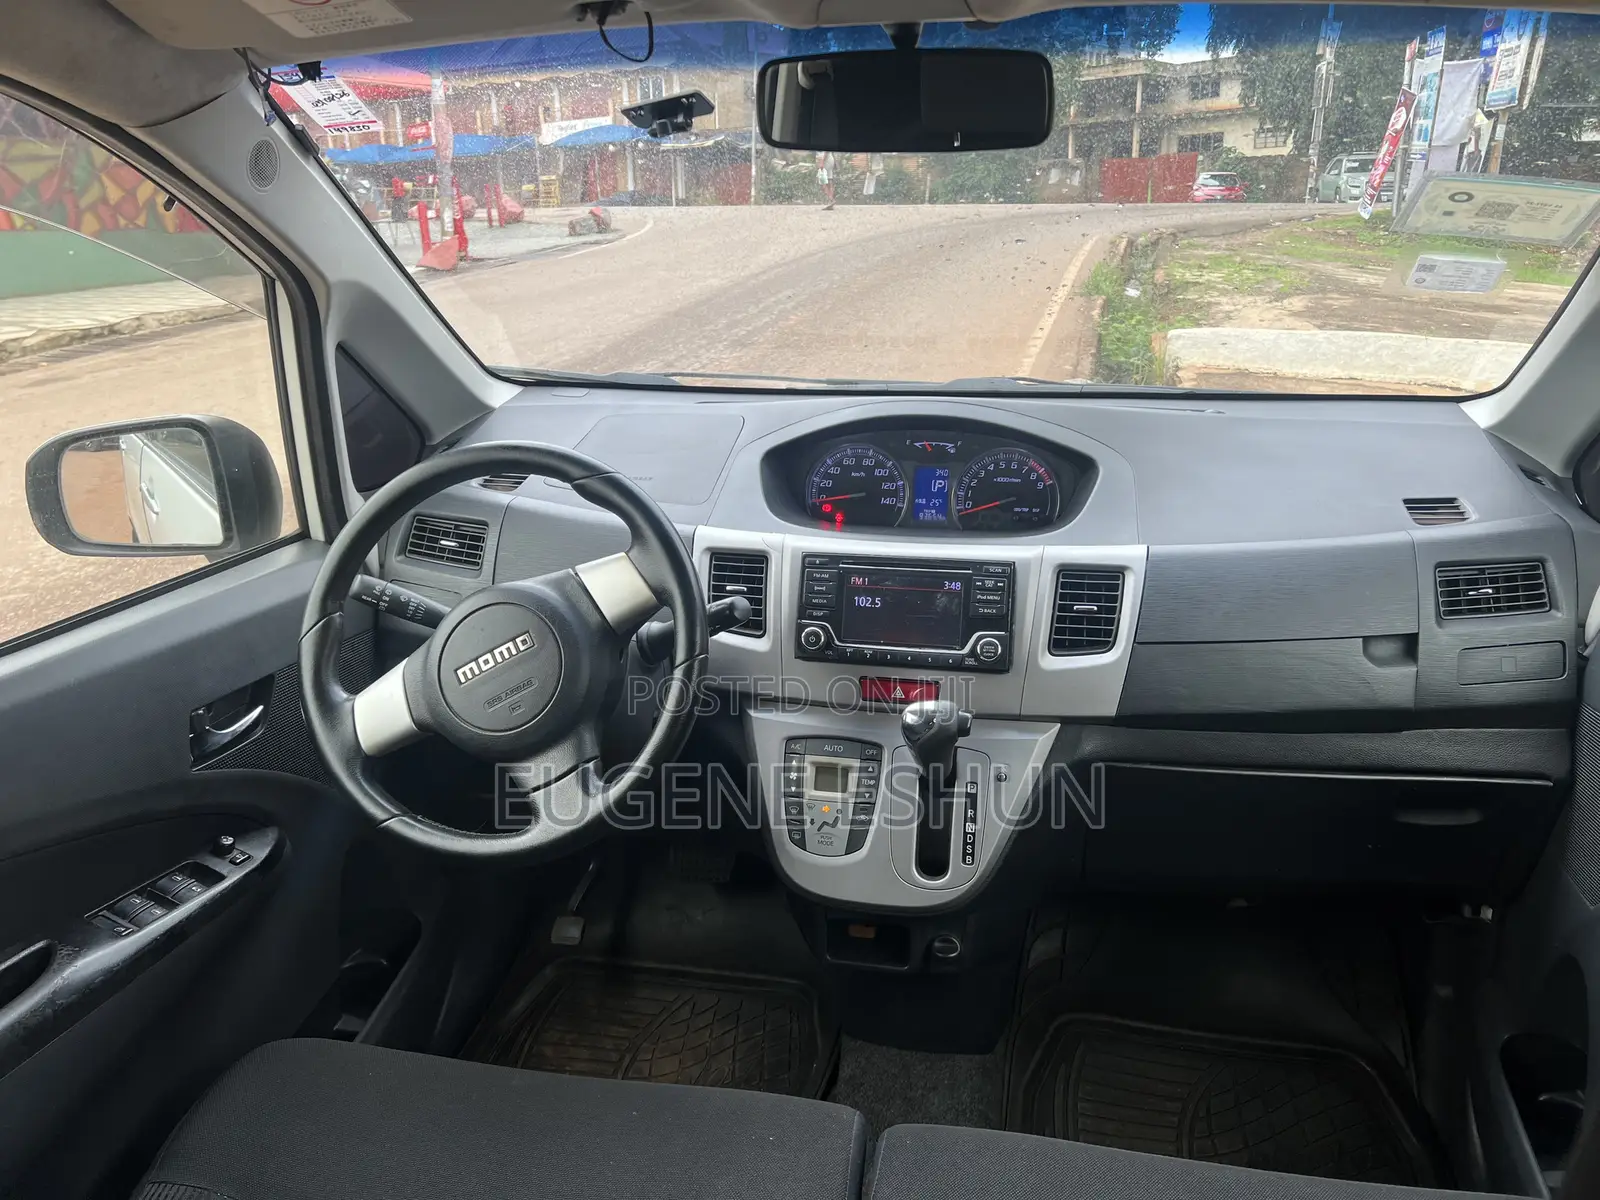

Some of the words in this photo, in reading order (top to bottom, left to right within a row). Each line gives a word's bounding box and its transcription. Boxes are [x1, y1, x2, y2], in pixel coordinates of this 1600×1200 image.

[944, 581, 961, 590] 3:48
[854, 596, 881, 608] 102.5
[487, 695, 502, 707] SRS
[505, 680, 534, 698] AIRBAG
[968, 809, 974, 818] R
[966, 845, 972, 853] S
